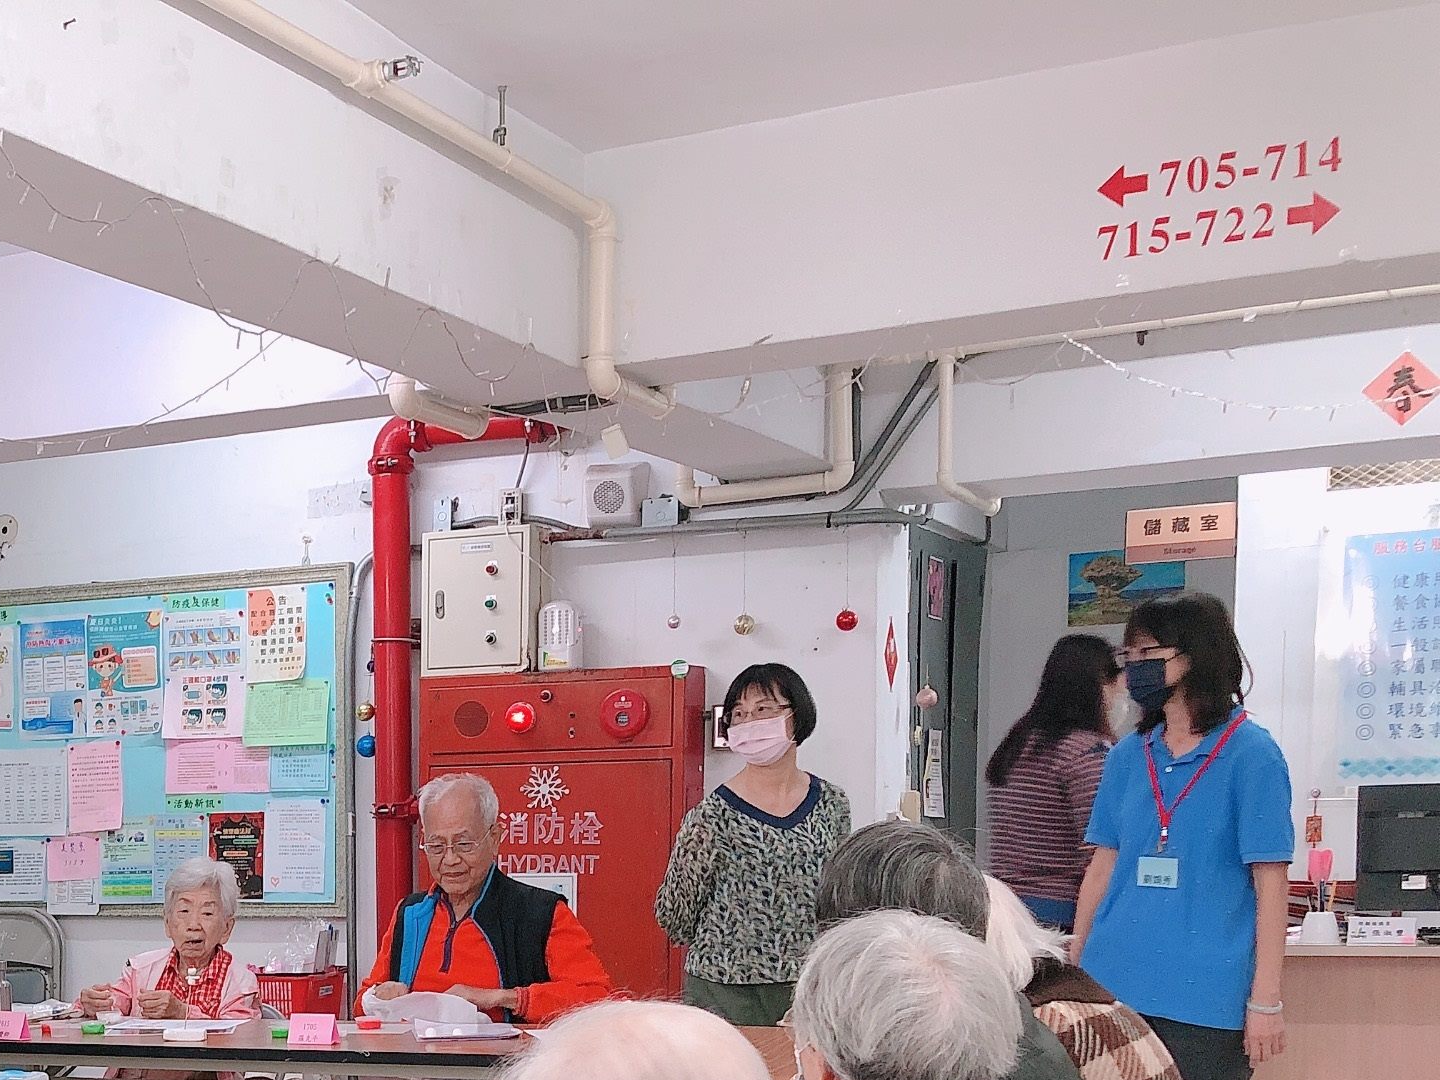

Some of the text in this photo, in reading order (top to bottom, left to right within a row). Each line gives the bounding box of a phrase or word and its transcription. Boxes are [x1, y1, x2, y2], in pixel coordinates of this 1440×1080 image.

[1159, 136, 1343, 198] 705-714
[1096, 203, 1275, 262] 715-722
[1143, 514, 1219, 537] 儲藏室
[1163, 546, 1197, 555] Storage
[171, 597, 220, 609] 防疫及保健
[266, 595, 287, 606] 公告
[173, 798, 216, 809] 活動新訊
[499, 811, 604, 845] 消防栓
[497, 854, 600, 875] HYDRANT
